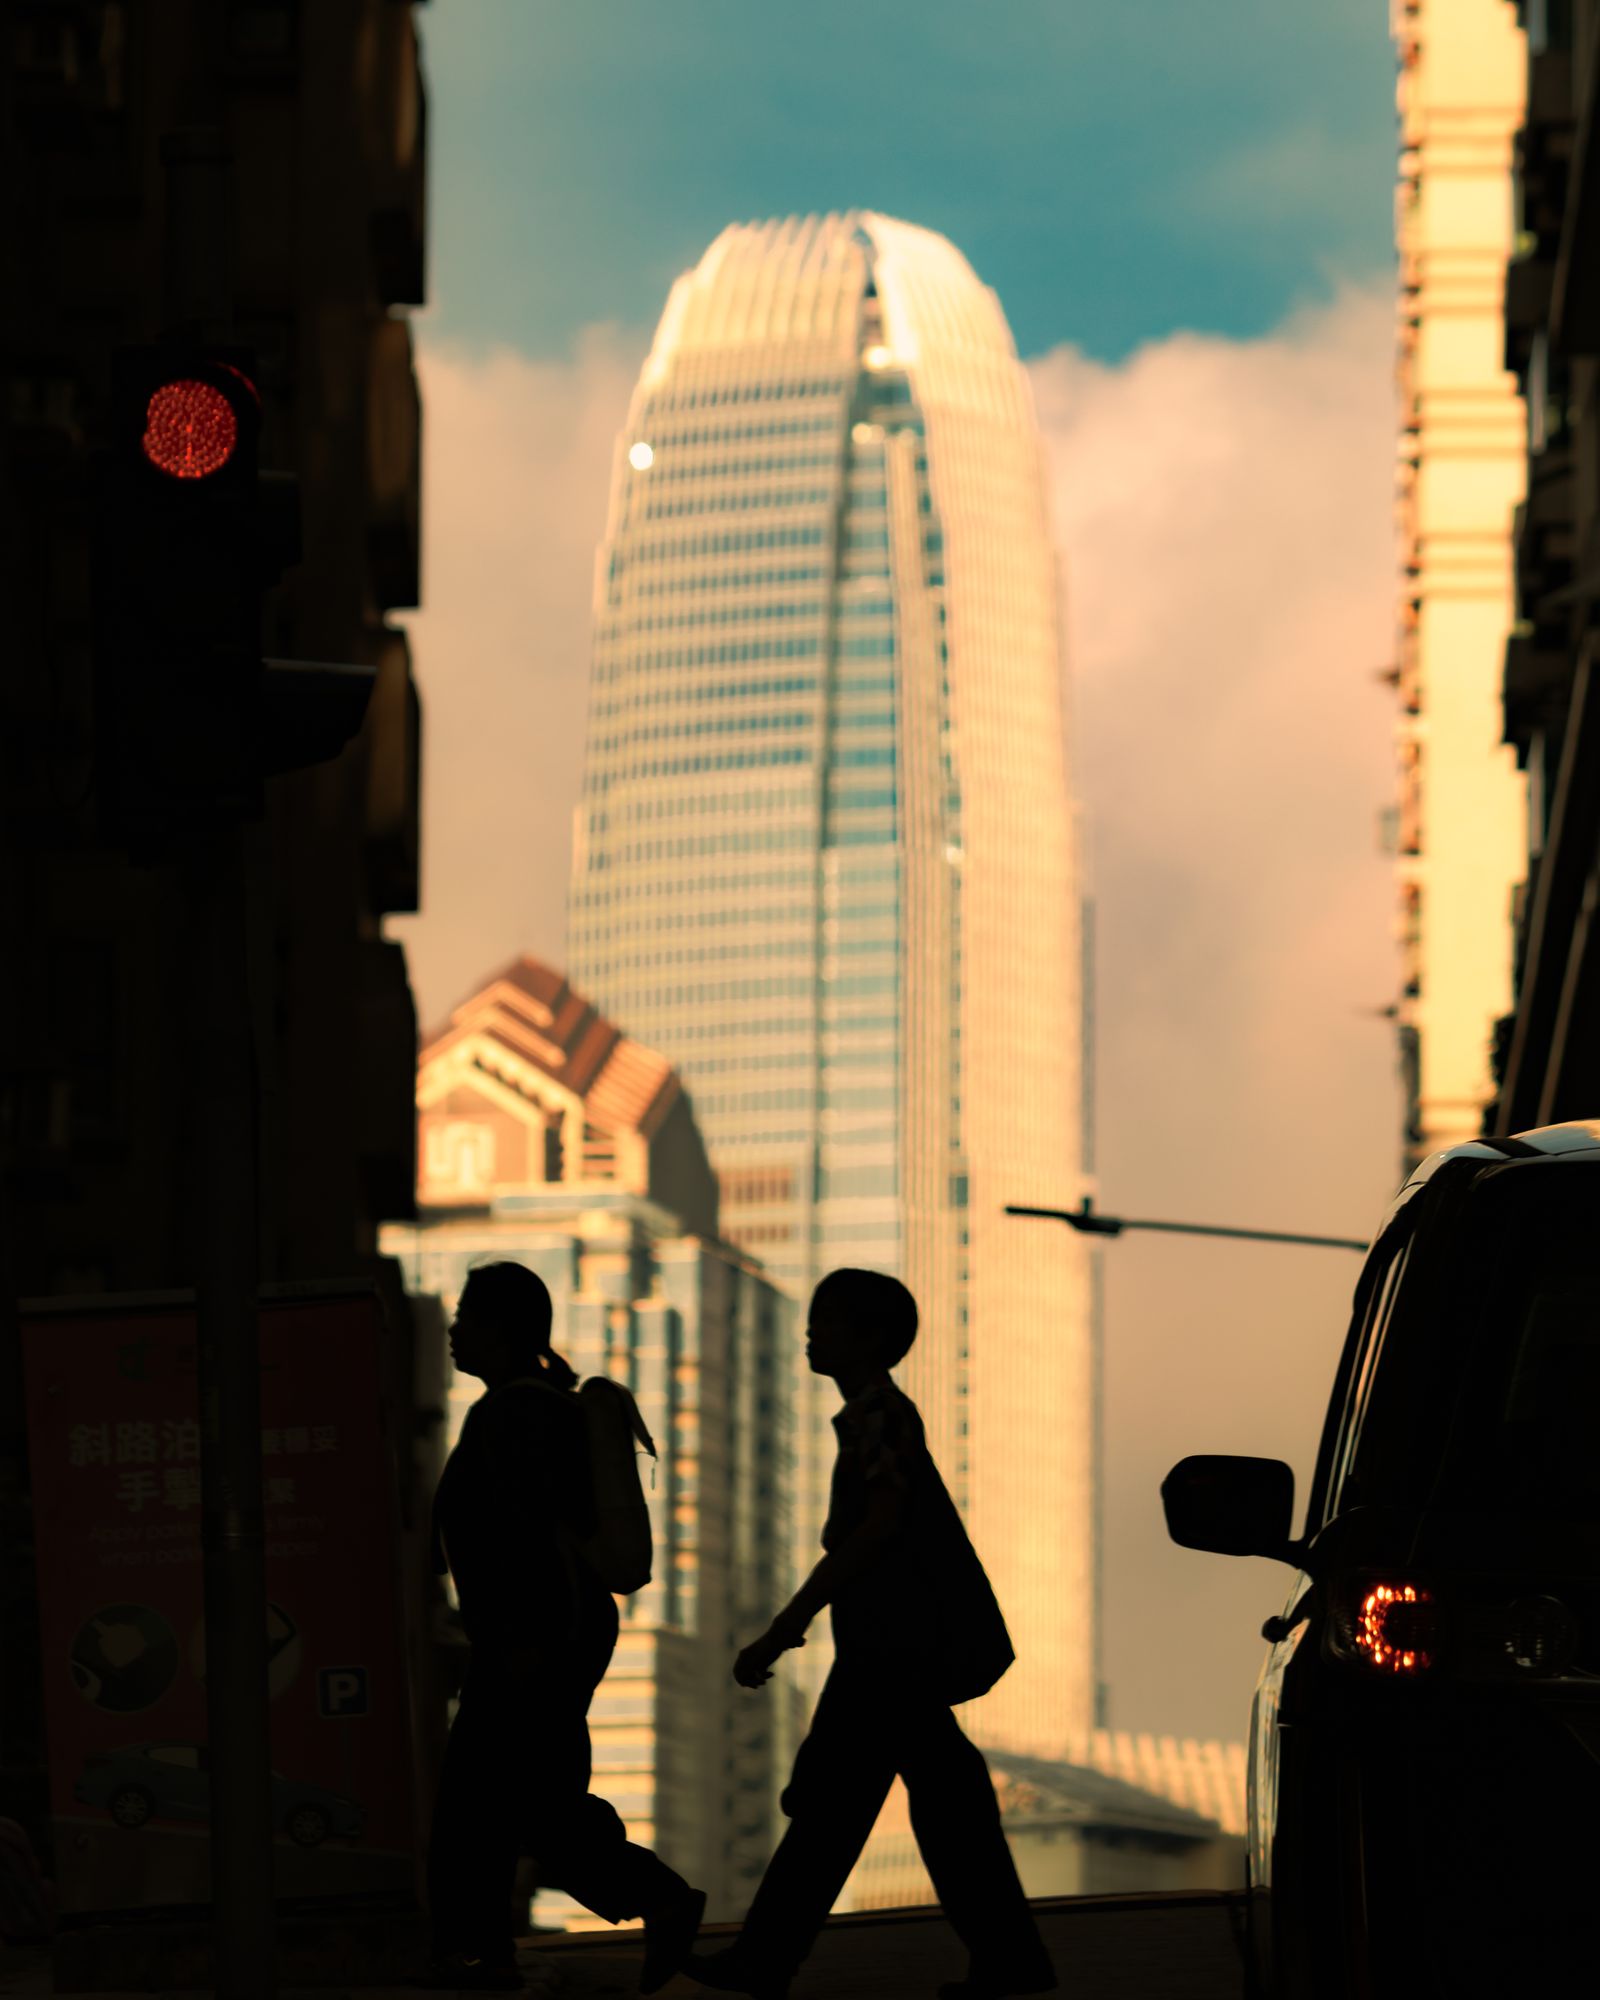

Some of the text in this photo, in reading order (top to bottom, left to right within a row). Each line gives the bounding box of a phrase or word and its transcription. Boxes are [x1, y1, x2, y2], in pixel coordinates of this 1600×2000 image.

[88, 1523, 142, 1544] Apply
[98, 1550, 151, 1568] when
[328, 1673, 359, 1712] P
